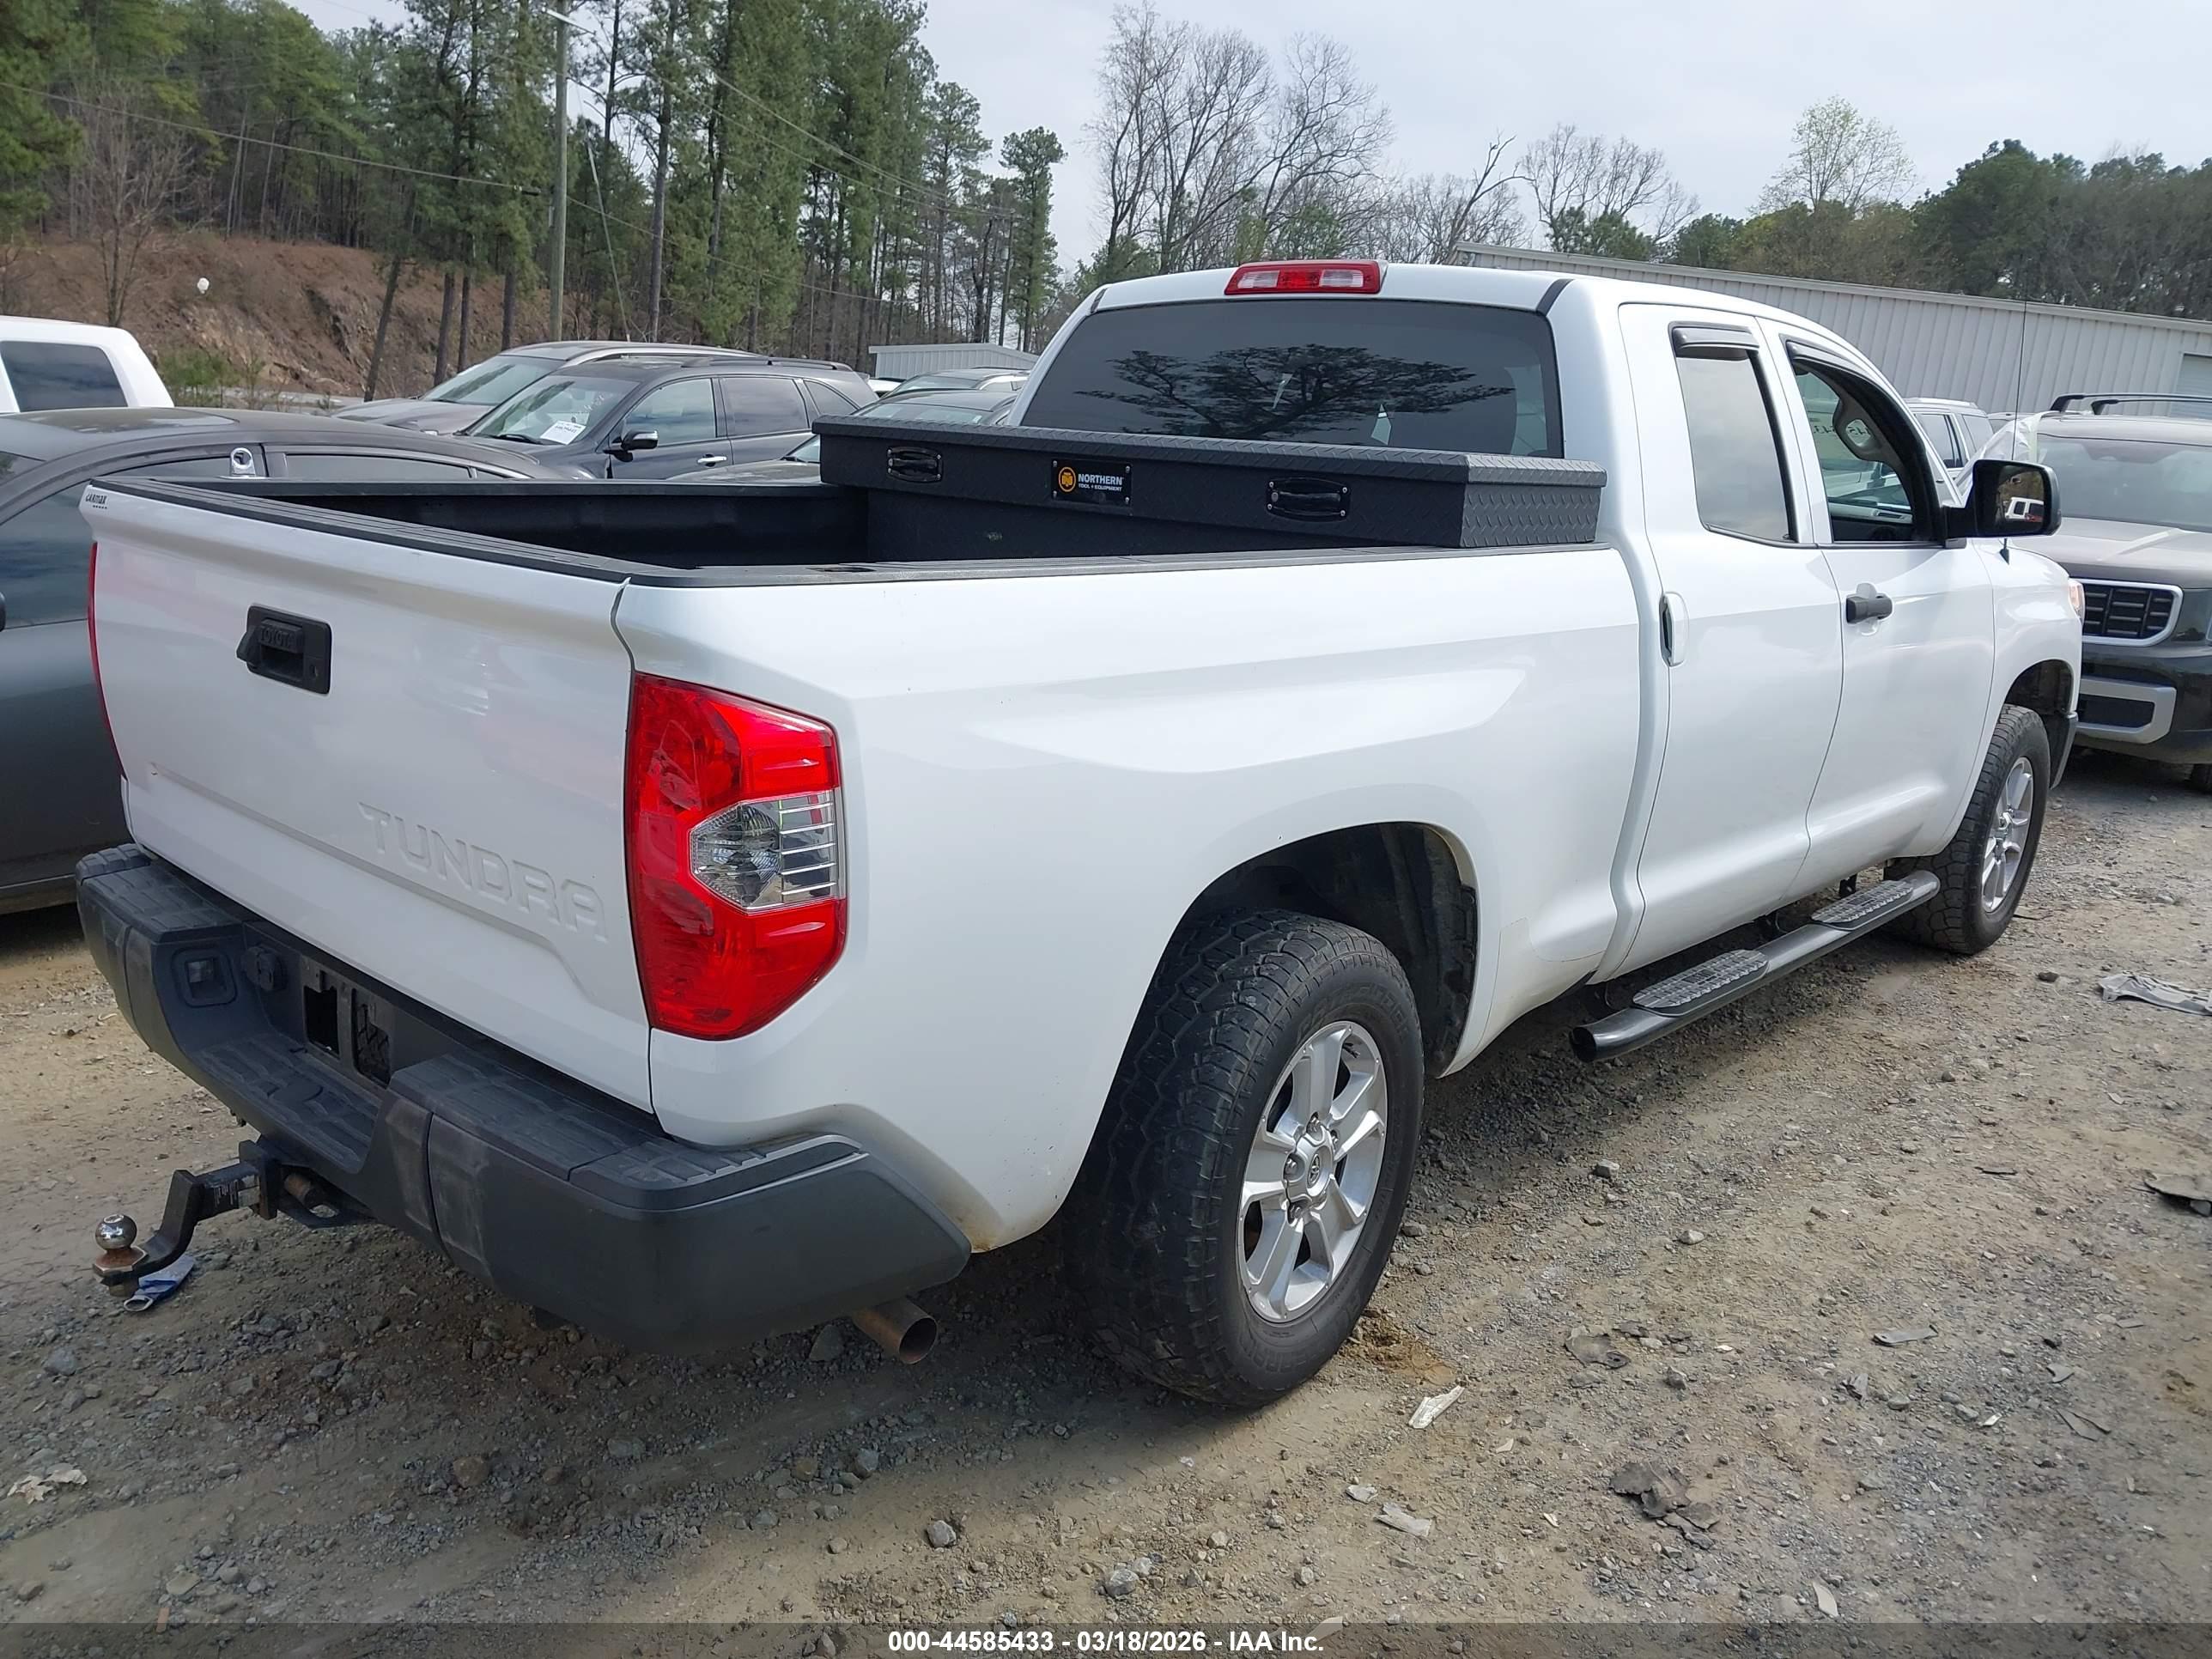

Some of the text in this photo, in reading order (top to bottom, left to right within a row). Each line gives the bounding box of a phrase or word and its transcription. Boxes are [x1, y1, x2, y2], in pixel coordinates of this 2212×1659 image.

[1078, 473, 1122, 486] NORTHERN
[259, 625, 297, 653] TOYOTA
[357, 801, 609, 943] TUNDRA
